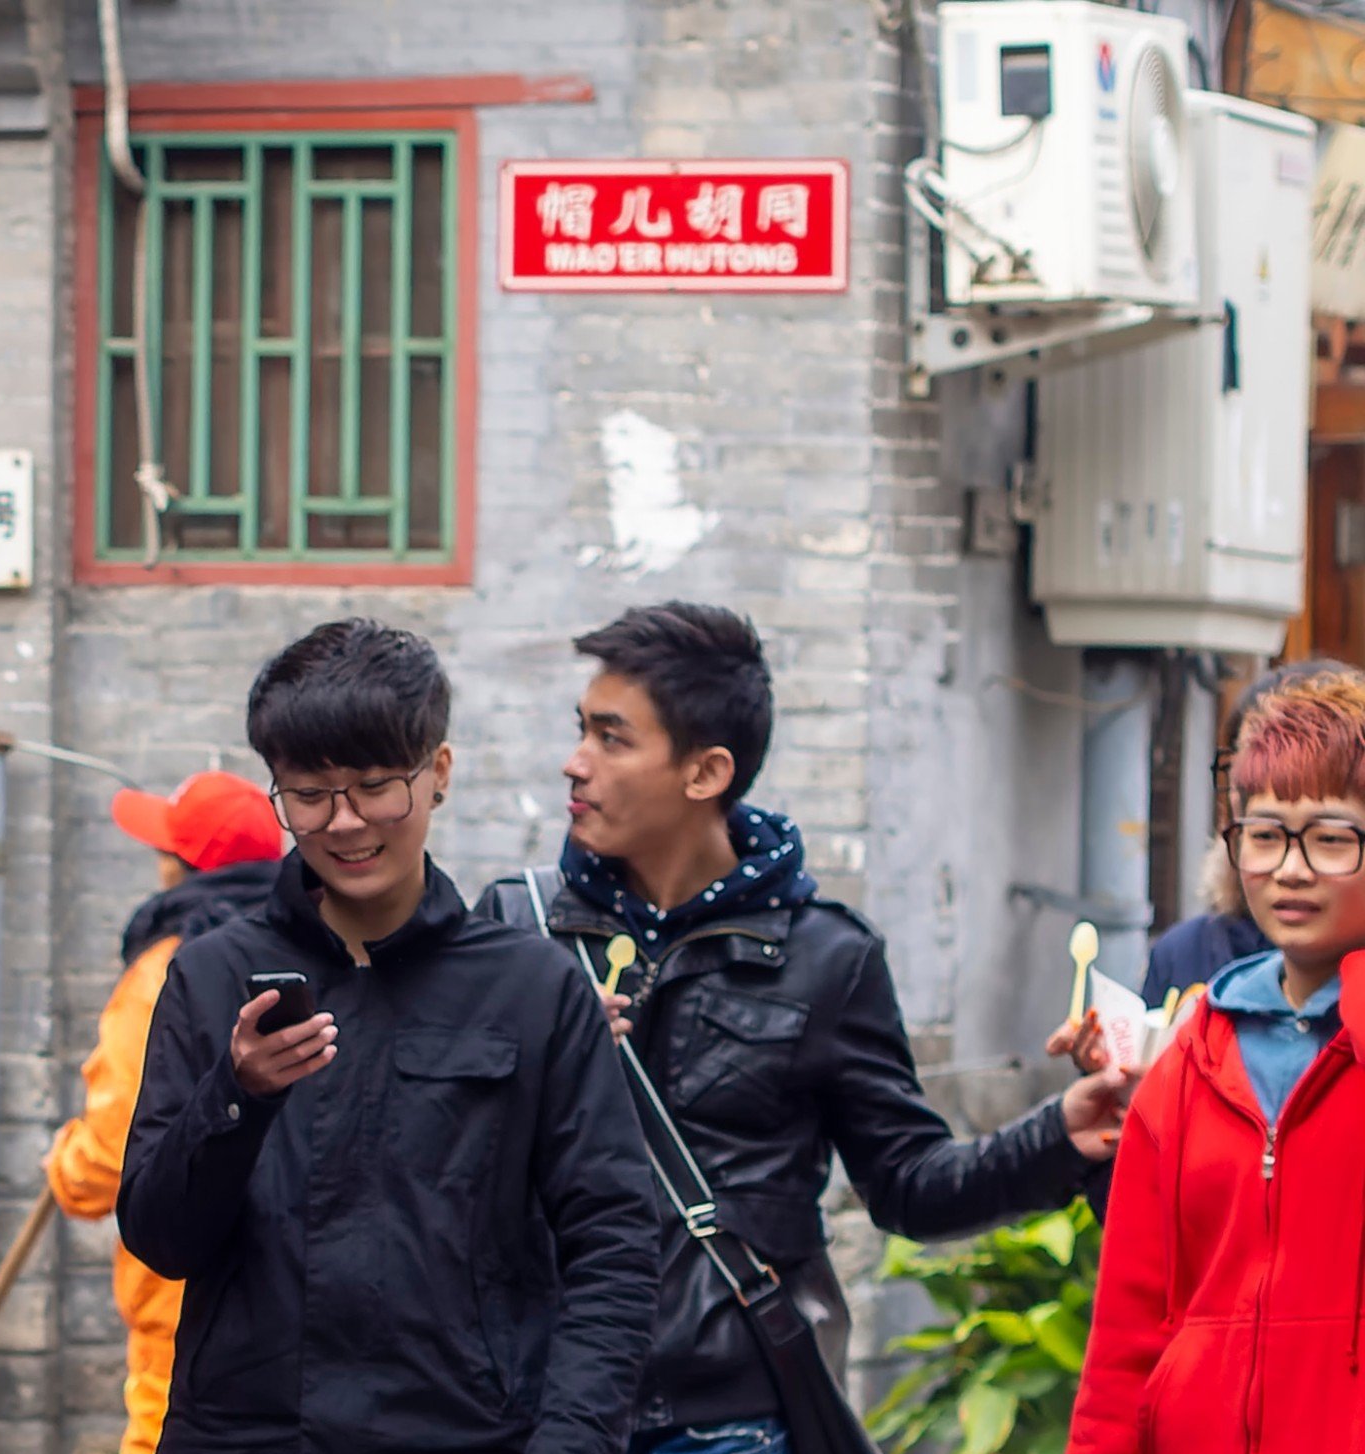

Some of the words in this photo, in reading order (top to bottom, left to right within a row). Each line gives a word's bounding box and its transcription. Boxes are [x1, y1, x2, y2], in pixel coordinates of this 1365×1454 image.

[536, 181, 810, 240] 帽儿胡同
[664, 242, 799, 273] HUTONG
